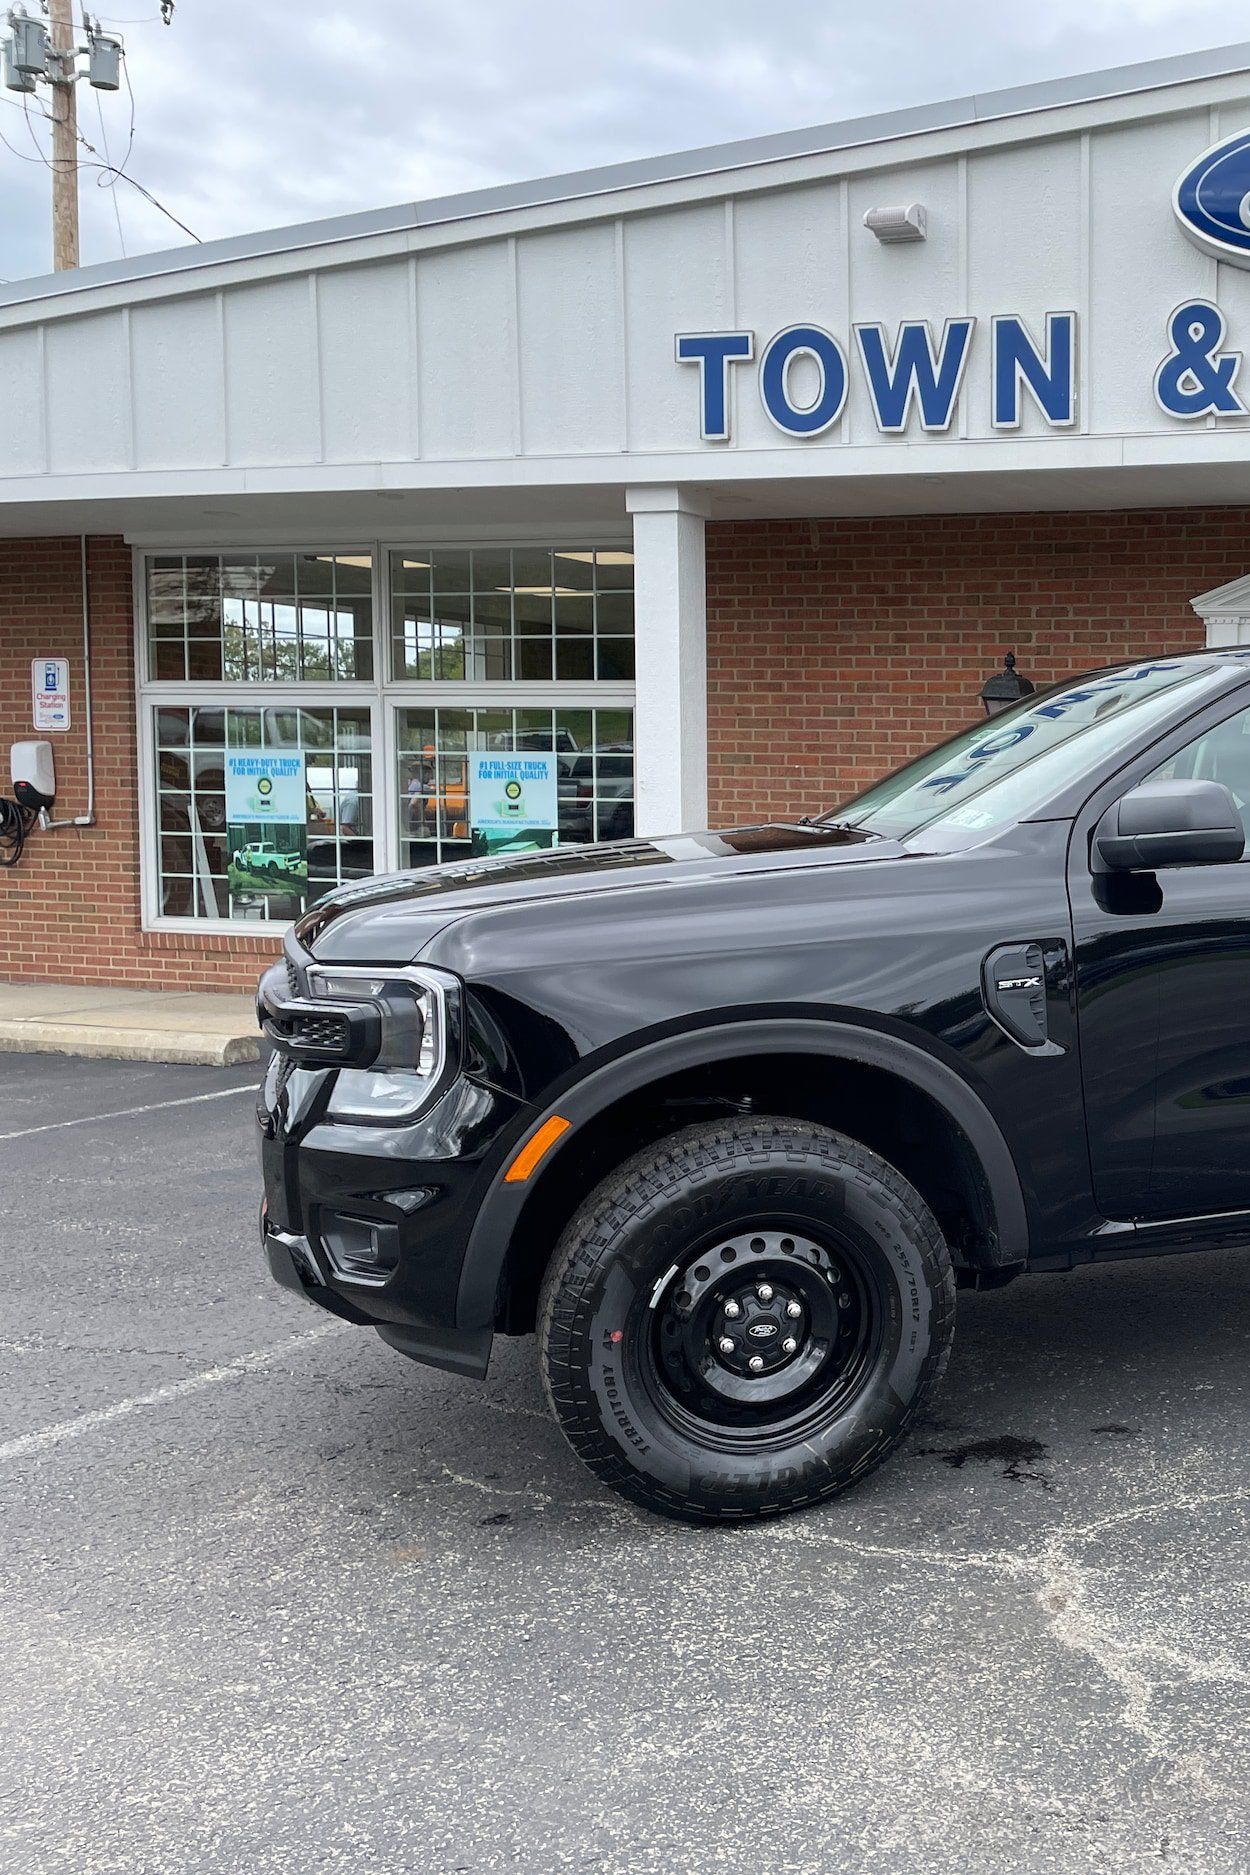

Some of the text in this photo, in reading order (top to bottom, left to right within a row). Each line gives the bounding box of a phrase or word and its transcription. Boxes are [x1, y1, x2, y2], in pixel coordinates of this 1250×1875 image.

[673, 310, 1078, 442] TOWN
[36, 693, 66, 702] Charging
[39, 701, 64, 709] Station
[229, 758, 301, 768] #1 HEAVY-DUTY TRUCK
[479, 761, 547, 770] #1 FULL-SIZE TRUCK
[232, 767, 298, 778] FOR INITIAL QUALITY
[478, 770, 549, 781] FOR INITIAL QUALITY
[997, 976, 1041, 990] STX
[602, 1364, 653, 1456] TERRITORY
